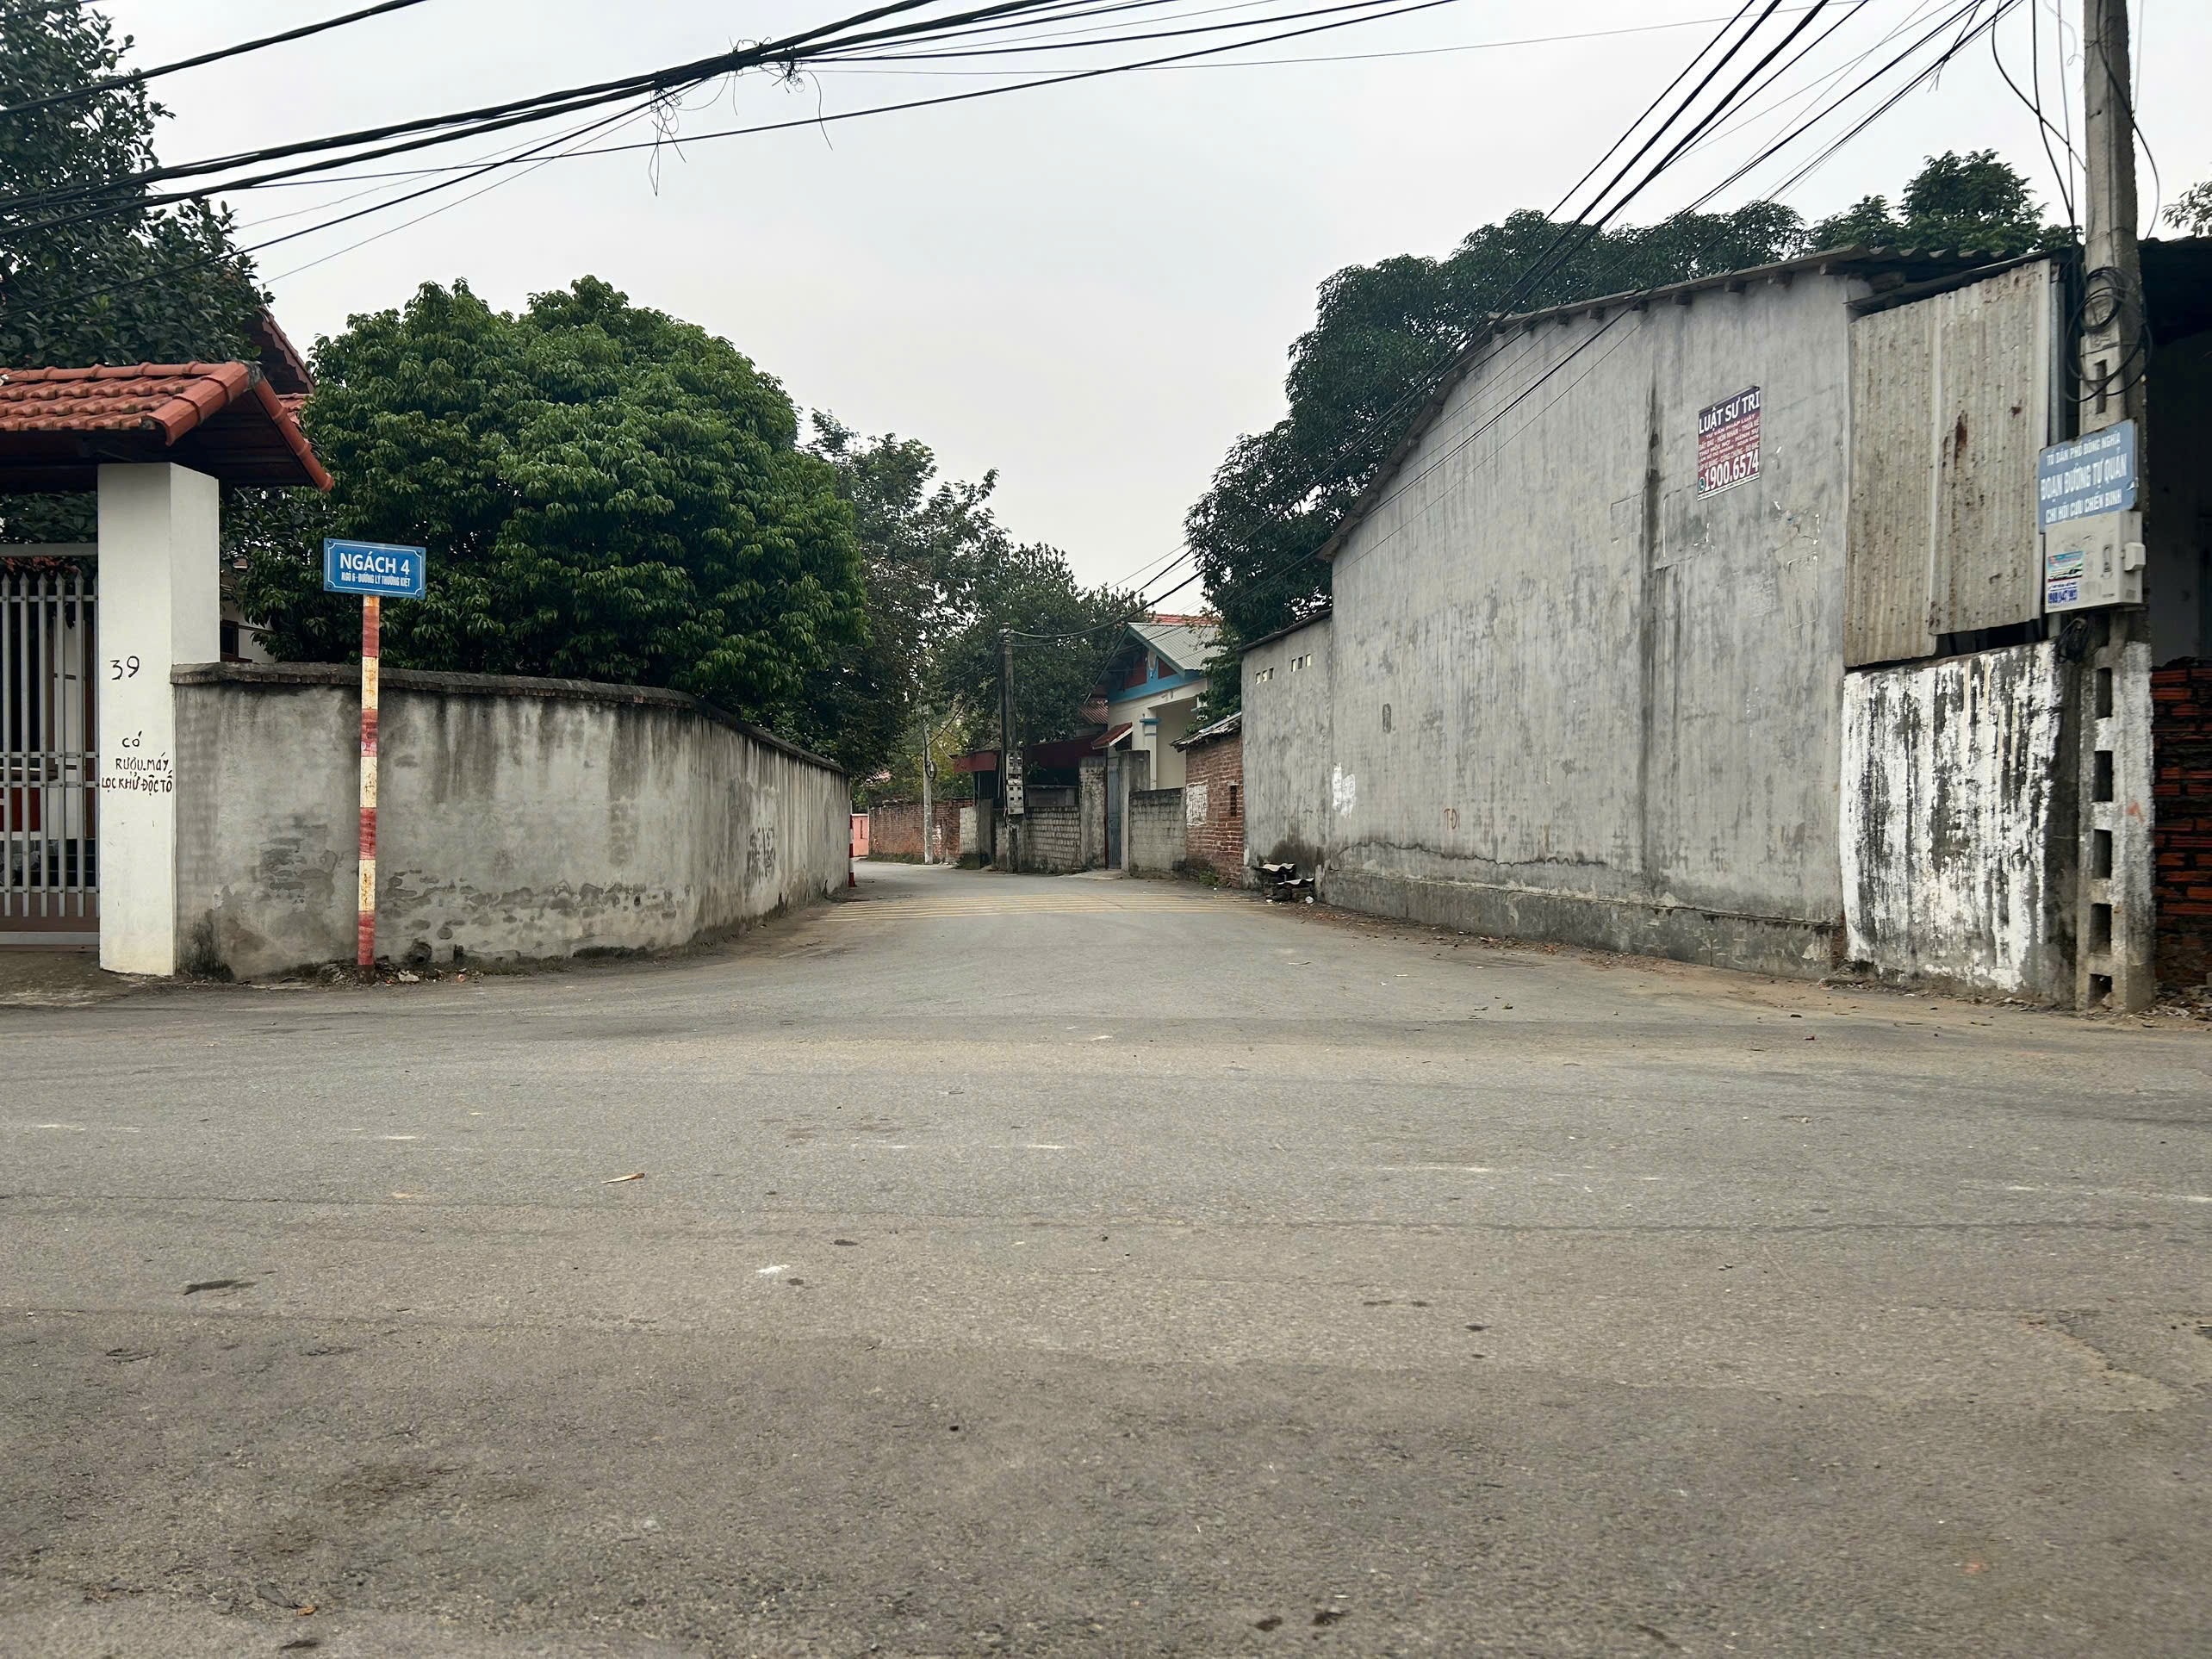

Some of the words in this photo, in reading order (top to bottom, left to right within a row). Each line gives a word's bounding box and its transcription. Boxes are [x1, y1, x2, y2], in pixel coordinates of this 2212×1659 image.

[1699, 407, 1723, 435] LUẬT
[1725, 395, 1740, 422] SƯ
[1705, 448, 1759, 492] 1900.6574
[339, 551, 396, 575] NGÁCH
[401, 559, 410, 575] 4
[110, 656, 140, 680] 39
